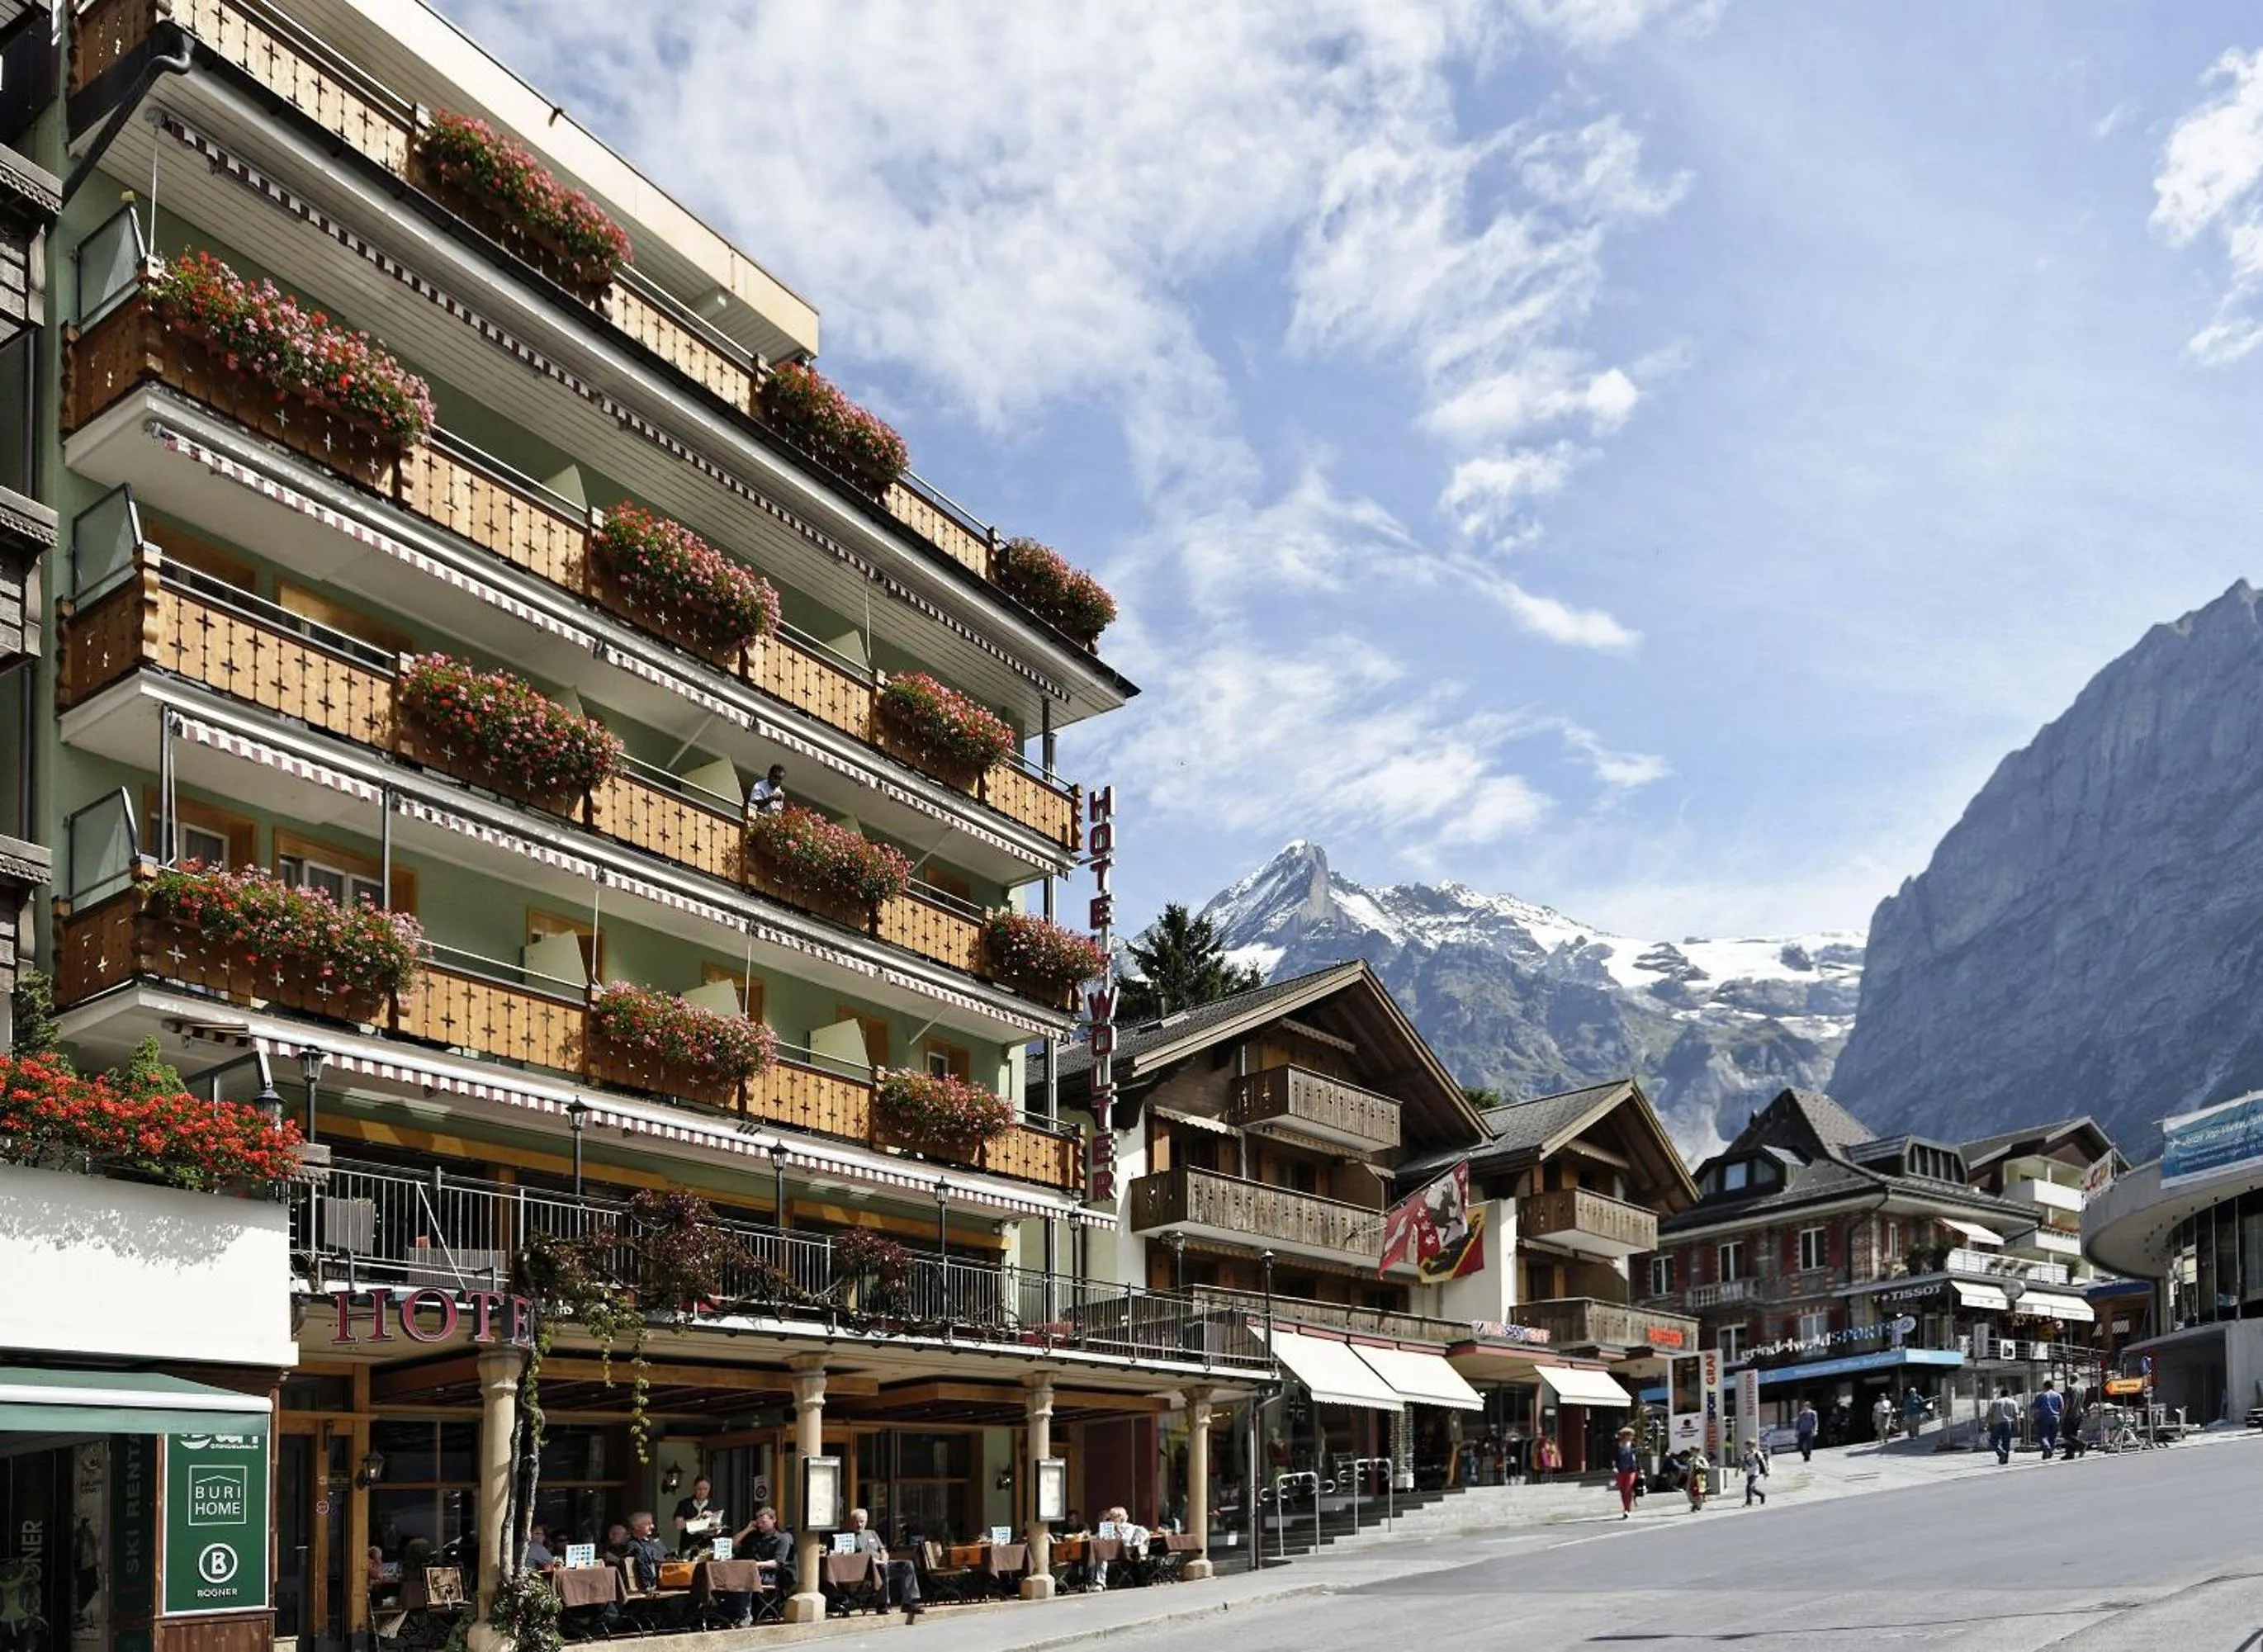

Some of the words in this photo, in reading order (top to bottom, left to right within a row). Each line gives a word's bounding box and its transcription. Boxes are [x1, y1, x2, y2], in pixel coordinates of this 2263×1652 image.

[1088, 785, 1115, 959] HOTE
[1087, 987, 1119, 1201] WOLTER
[1889, 1283, 1943, 1301] TISSOT
[329, 1285, 537, 1349] HOTE
[195, 1485, 241, 1499] BURI
[195, 1502, 241, 1516] HOME
[125, 1529, 141, 1575] SKI
